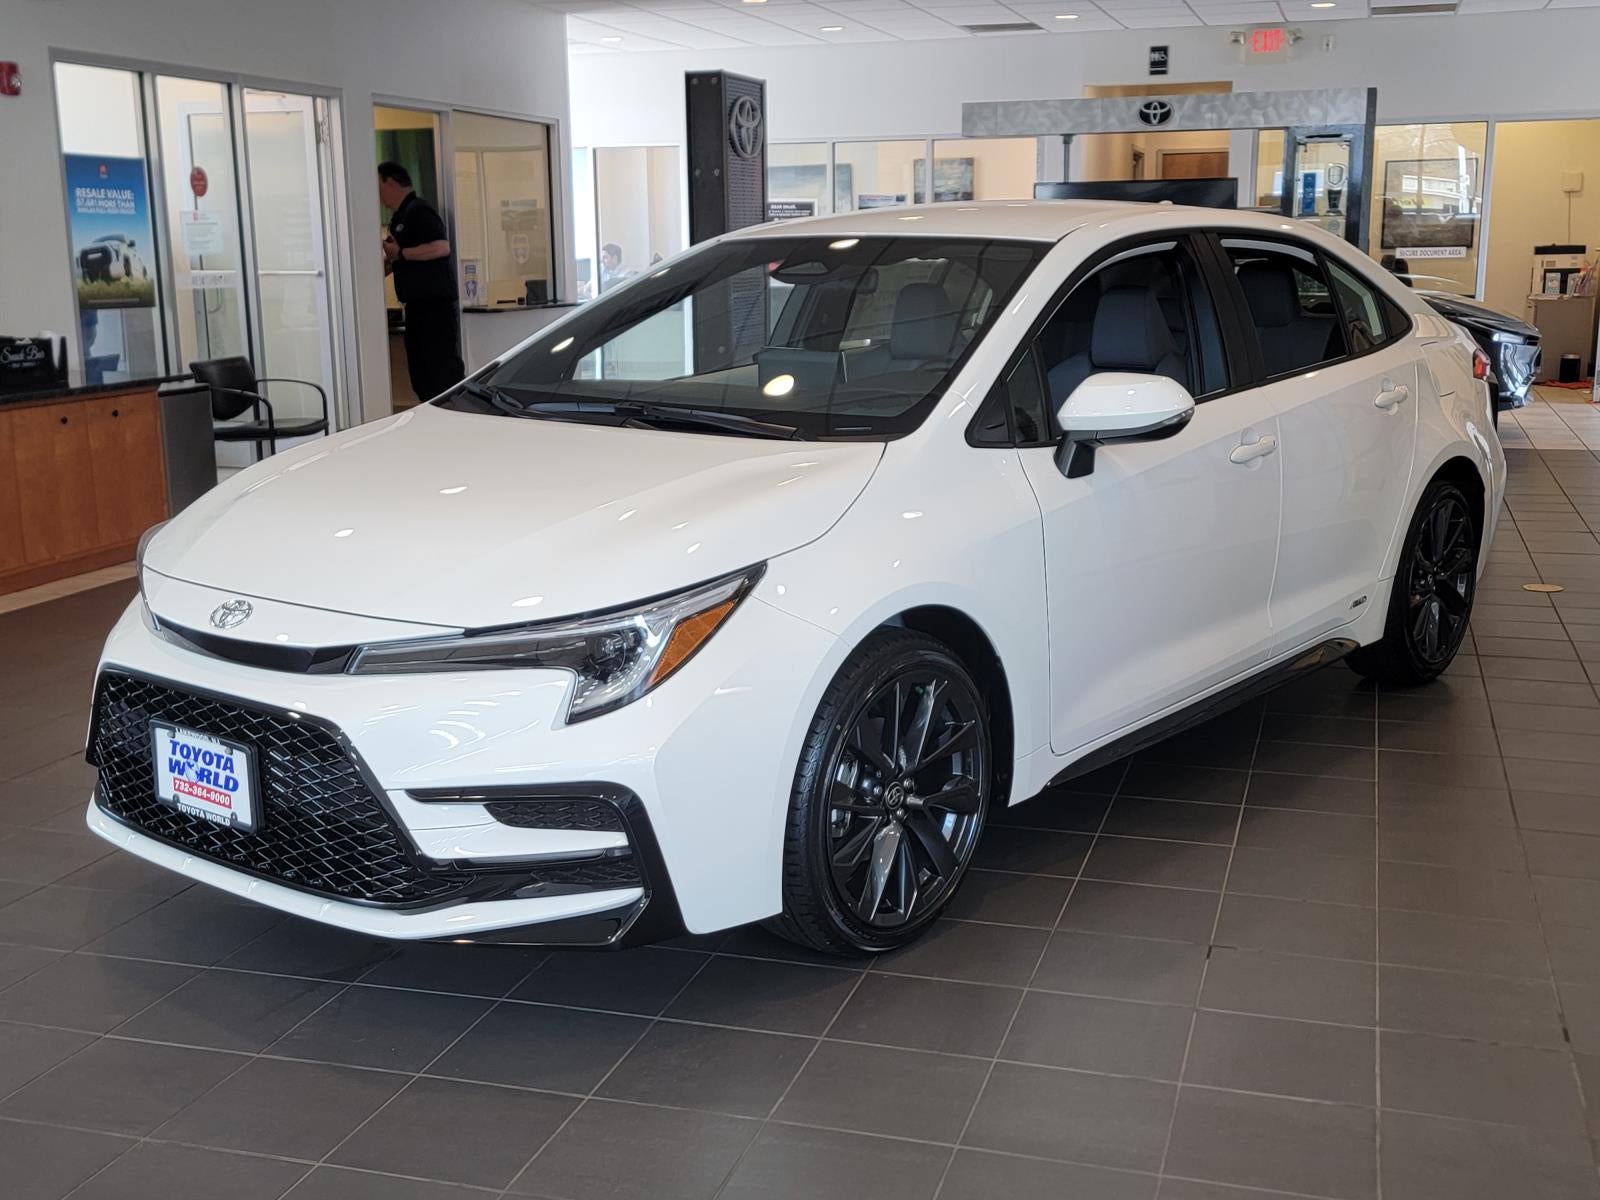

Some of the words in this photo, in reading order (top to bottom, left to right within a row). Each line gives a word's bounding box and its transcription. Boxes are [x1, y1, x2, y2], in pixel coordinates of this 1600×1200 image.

[1252, 29, 1281, 52] EXIT
[75, 187, 105, 198] RESALE
[97, 199, 117, 208] MORE
[118, 199, 135, 209] THAN
[1399, 249, 1419, 257] SECURE
[1420, 249, 1447, 257] DOCUMENT
[170, 740, 234, 774] TOYOTA
[174, 779, 230, 806] 732-364-9000
[177, 803, 205, 818] TOYOTA
[205, 811, 230, 826] WORLD
